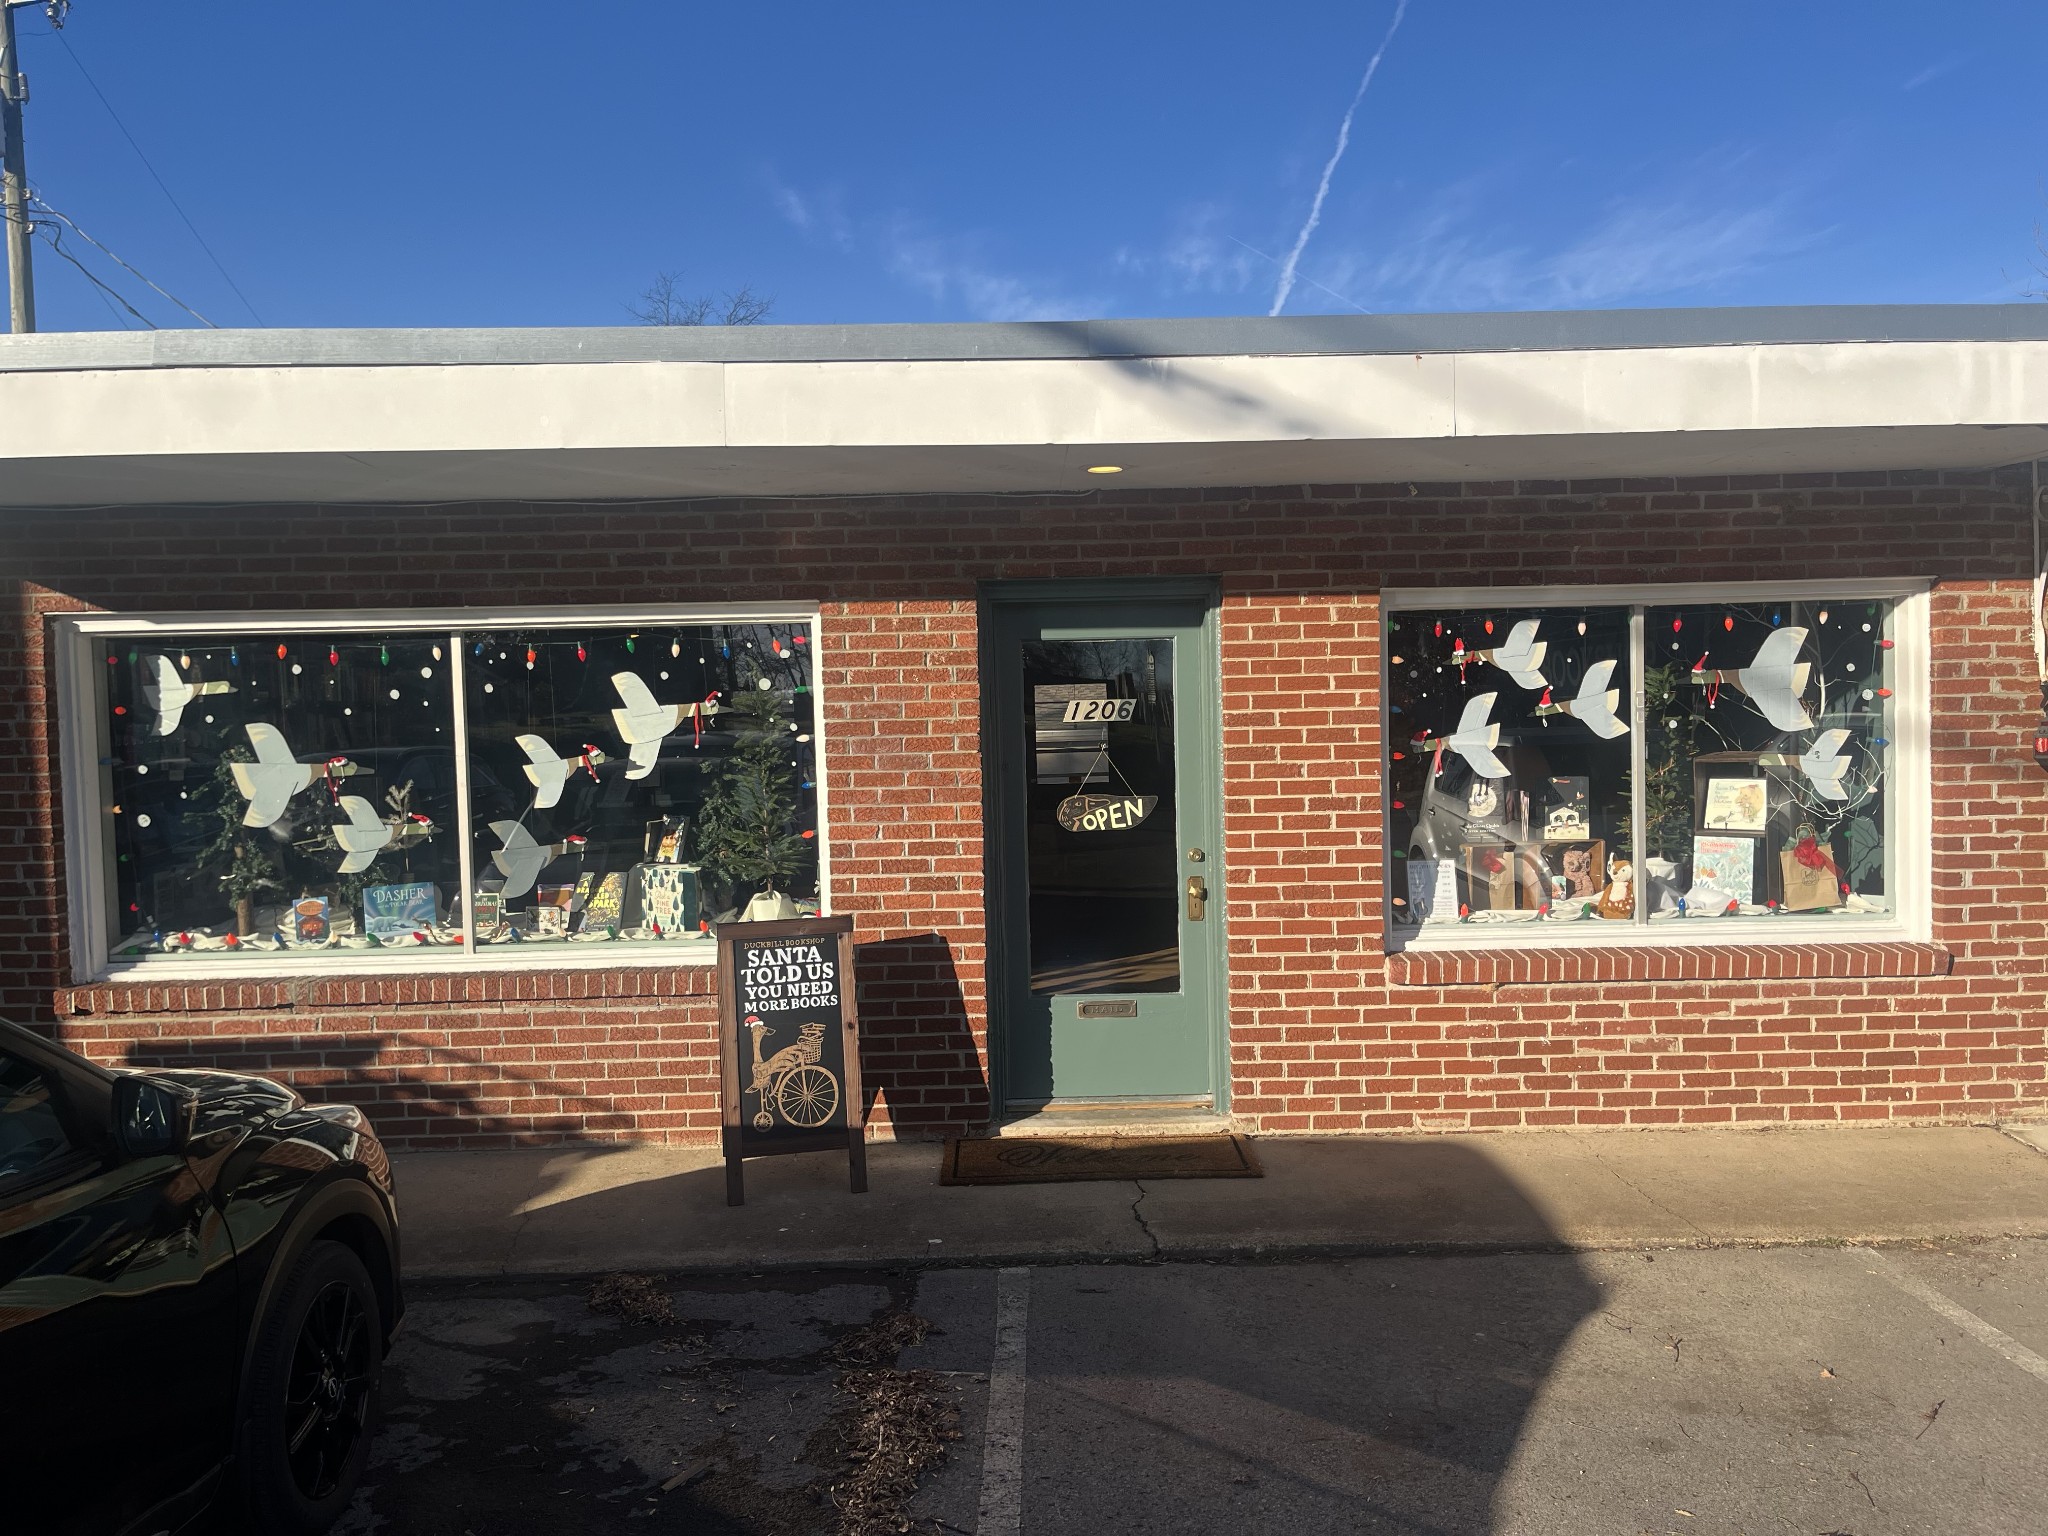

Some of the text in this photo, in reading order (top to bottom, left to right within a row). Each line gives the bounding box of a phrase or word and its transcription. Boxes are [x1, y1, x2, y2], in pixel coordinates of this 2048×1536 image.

[1071, 701, 1133, 720] 1206
[1083, 799, 1143, 831] OPEN
[373, 888, 428, 903] DASHER
[655, 906, 671, 915] TREE
[744, 938, 825, 950] DUCKBILL BOOKSHOP
[747, 946, 823, 968] SANTA
[740, 962, 834, 985] TOLD US
[745, 981, 833, 1000] YOU NEED
[744, 995, 838, 1013] MORE BOOKS
